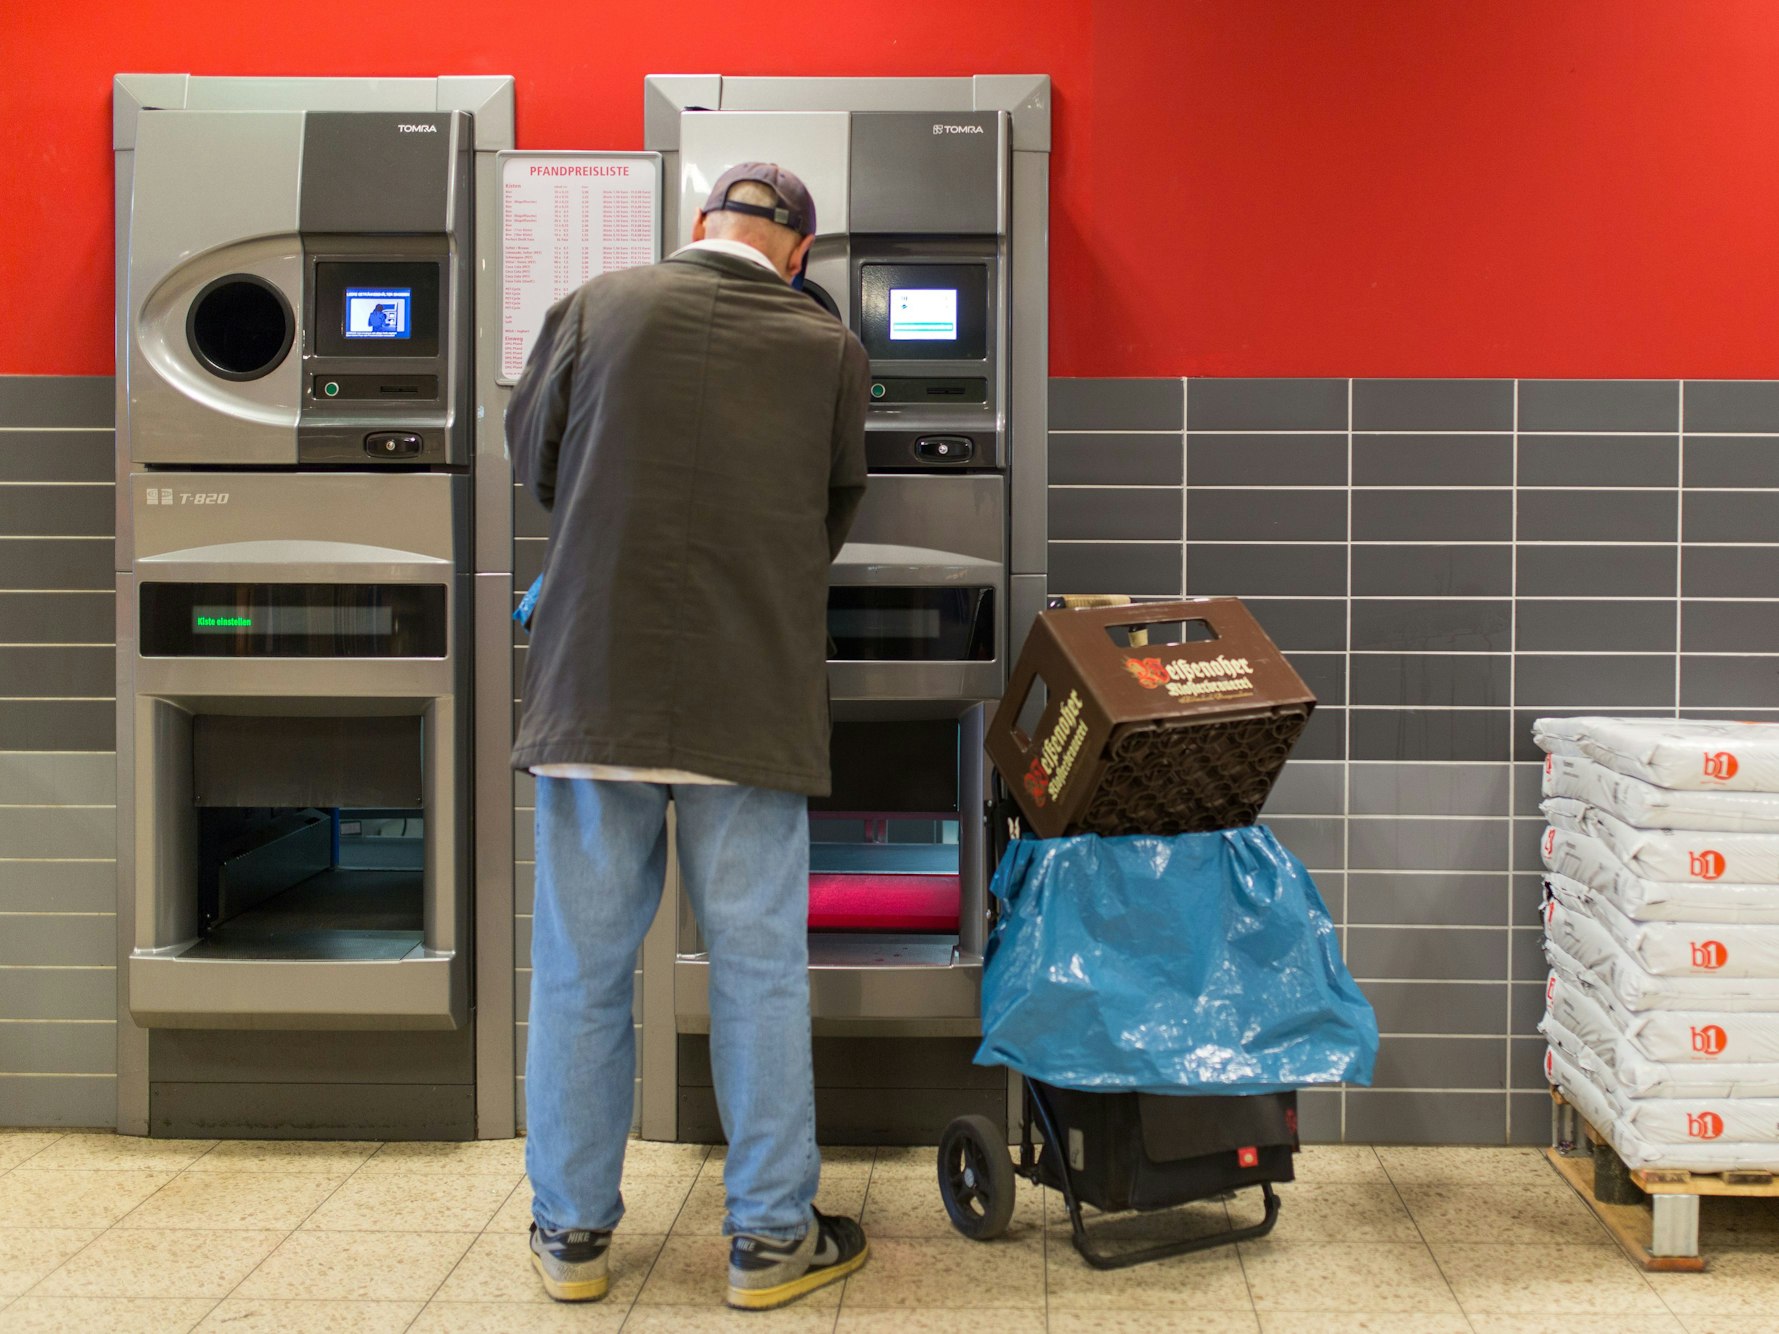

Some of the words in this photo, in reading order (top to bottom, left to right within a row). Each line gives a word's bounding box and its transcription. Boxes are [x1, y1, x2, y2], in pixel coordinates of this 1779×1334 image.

[398, 124, 437, 133] TOMRA
[944, 125, 984, 134] TOMRA
[530, 166, 630, 176] PFANDPREISLISTE
[180, 493, 230, 505] T-820
[197, 617, 216, 626] Kiste
[216, 617, 252, 626] einstellen
[1703, 752, 1738, 780] b1
[1688, 850, 1726, 880] b1
[1689, 940, 1728, 969] b1
[1690, 1025, 1728, 1055] b1
[1686, 1112, 1724, 1140] b1
[567, 1232, 590, 1243] NIKE
